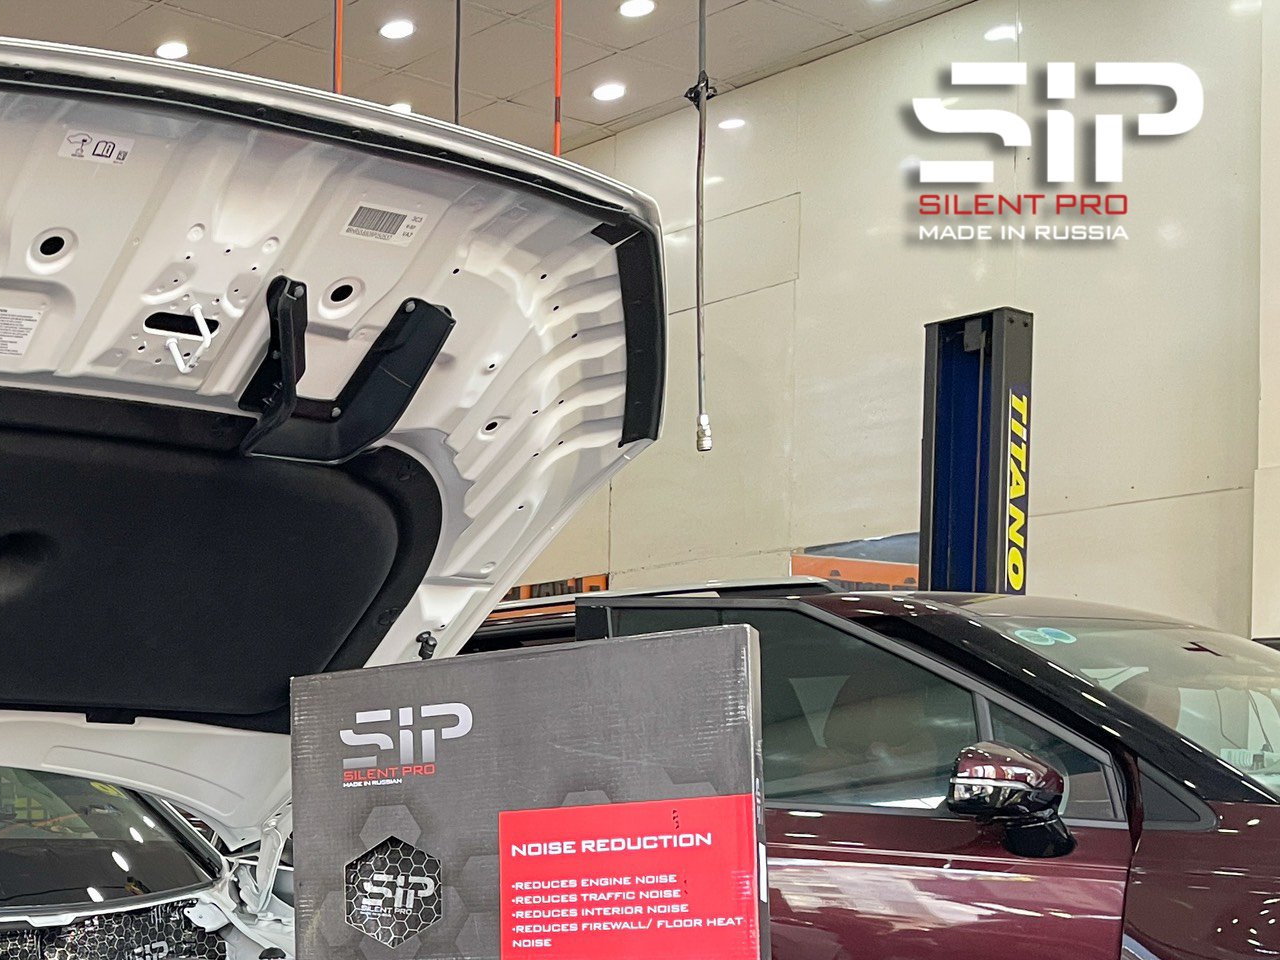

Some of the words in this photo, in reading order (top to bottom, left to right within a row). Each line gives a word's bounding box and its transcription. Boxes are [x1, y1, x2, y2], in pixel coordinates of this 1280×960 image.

[343, 767, 399, 781] SILENT
[401, 763, 436, 777] PRO
[371, 778, 403, 787] RUSSIAN
[511, 840, 577, 857] NOISE
[581, 832, 713, 854] REDUCTION
[581, 876, 632, 888] ENGINE
[635, 873, 678, 885] NOISE
[581, 890, 636, 902] TRAFFIC
[639, 889, 682, 900] NOISE
[360, 905, 393, 915] SILENT
[581, 905, 644, 917] INTERIOR
[647, 903, 690, 914] NOISE
[581, 918, 654, 931] FIREWALL/
[657, 917, 703, 929] FLOOR
[706, 916, 744, 927] HEAT
[512, 938, 552, 949] NOISE
